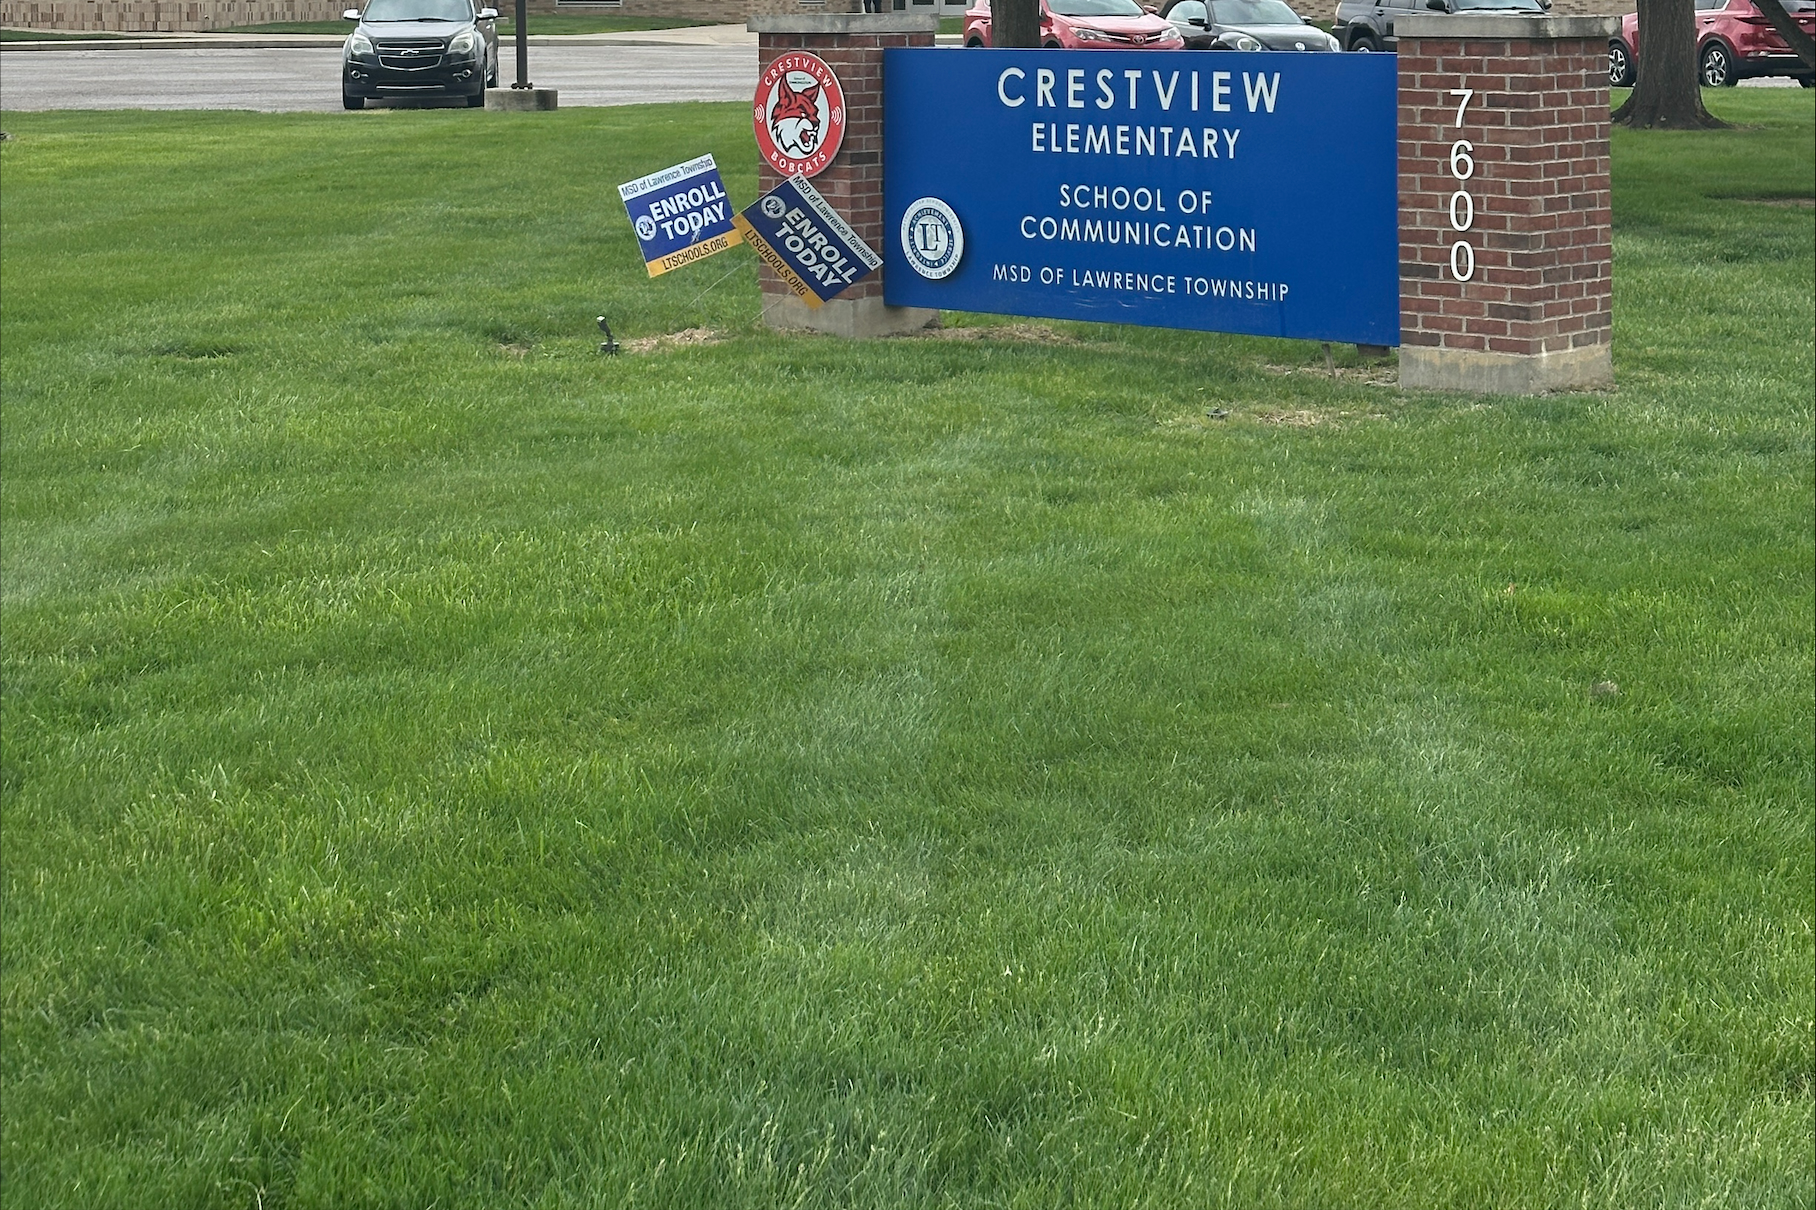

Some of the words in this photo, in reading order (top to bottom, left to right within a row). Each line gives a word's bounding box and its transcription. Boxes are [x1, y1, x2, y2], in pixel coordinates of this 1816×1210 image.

[764, 57, 832, 87] CRESTVIEW
[998, 67, 1281, 113] CRESTVIEW
[1032, 123, 1240, 159] ELEMENTARY
[621, 177, 639, 197] MSD
[640, 180, 647, 190] of
[647, 168, 681, 188] Lawrence
[680, 157, 713, 176] Township
[770, 151, 827, 173] BOBCATS
[649, 181, 726, 222] ENROLL
[1060, 184, 1166, 212] SCHOOL
[1178, 190, 1212, 214] OF
[1450, 89, 1475, 281] 7600
[660, 201, 725, 241] TODAY
[792, 175, 811, 195] MSD
[808, 194, 820, 205] of
[815, 201, 850, 236] Lawrence
[847, 233, 879, 267] Township
[1020, 215, 1257, 252] COMMUNICATION
[662, 236, 729, 270] LTSCHOOLS.ORG
[744, 229, 809, 296] LTSCHOOLS.ORG
[775, 222, 842, 287] TODAY
[785, 207, 858, 284] ENROLL
[993, 264, 1031, 282] MSD
[1040, 267, 1064, 285] OF
[1073, 269, 1176, 293] LAWRENCE
[1185, 276, 1289, 301] TOWNSHIP
